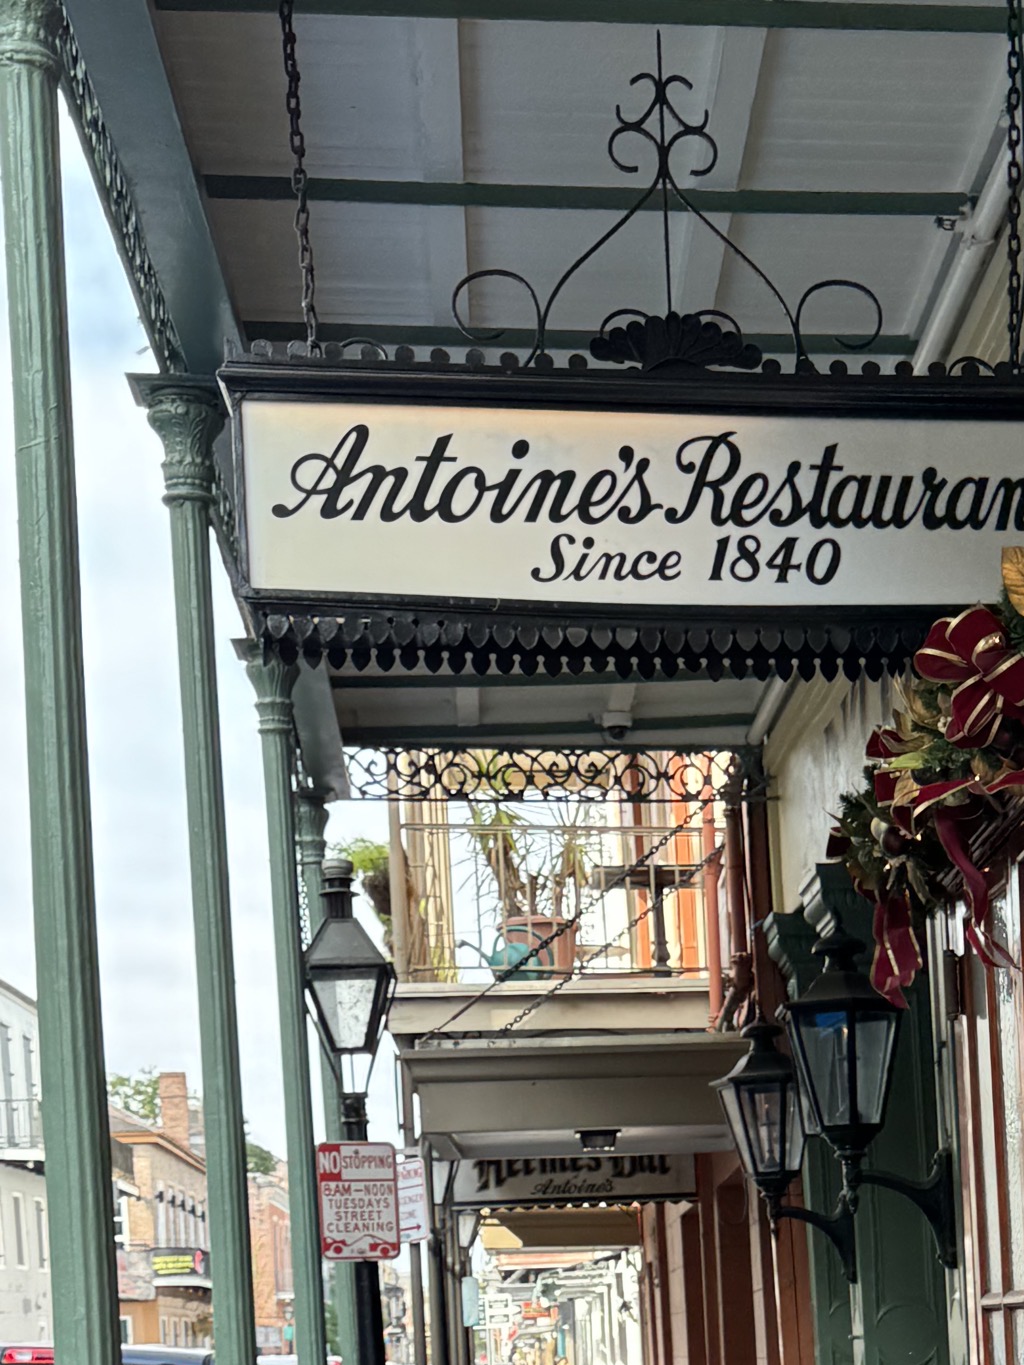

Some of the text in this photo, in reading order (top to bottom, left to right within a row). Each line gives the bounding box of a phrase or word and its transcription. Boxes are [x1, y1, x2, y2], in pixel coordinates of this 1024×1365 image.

[271, 423, 663, 526] Antoine's
[530, 533, 842, 587] Since 1840
[319, 1151, 392, 1174] NO STOPPING
[328, 1197, 391, 1210] TUESDAYS
[334, 1210, 383, 1222] STREET
[326, 1221, 394, 1233] CLEANING
